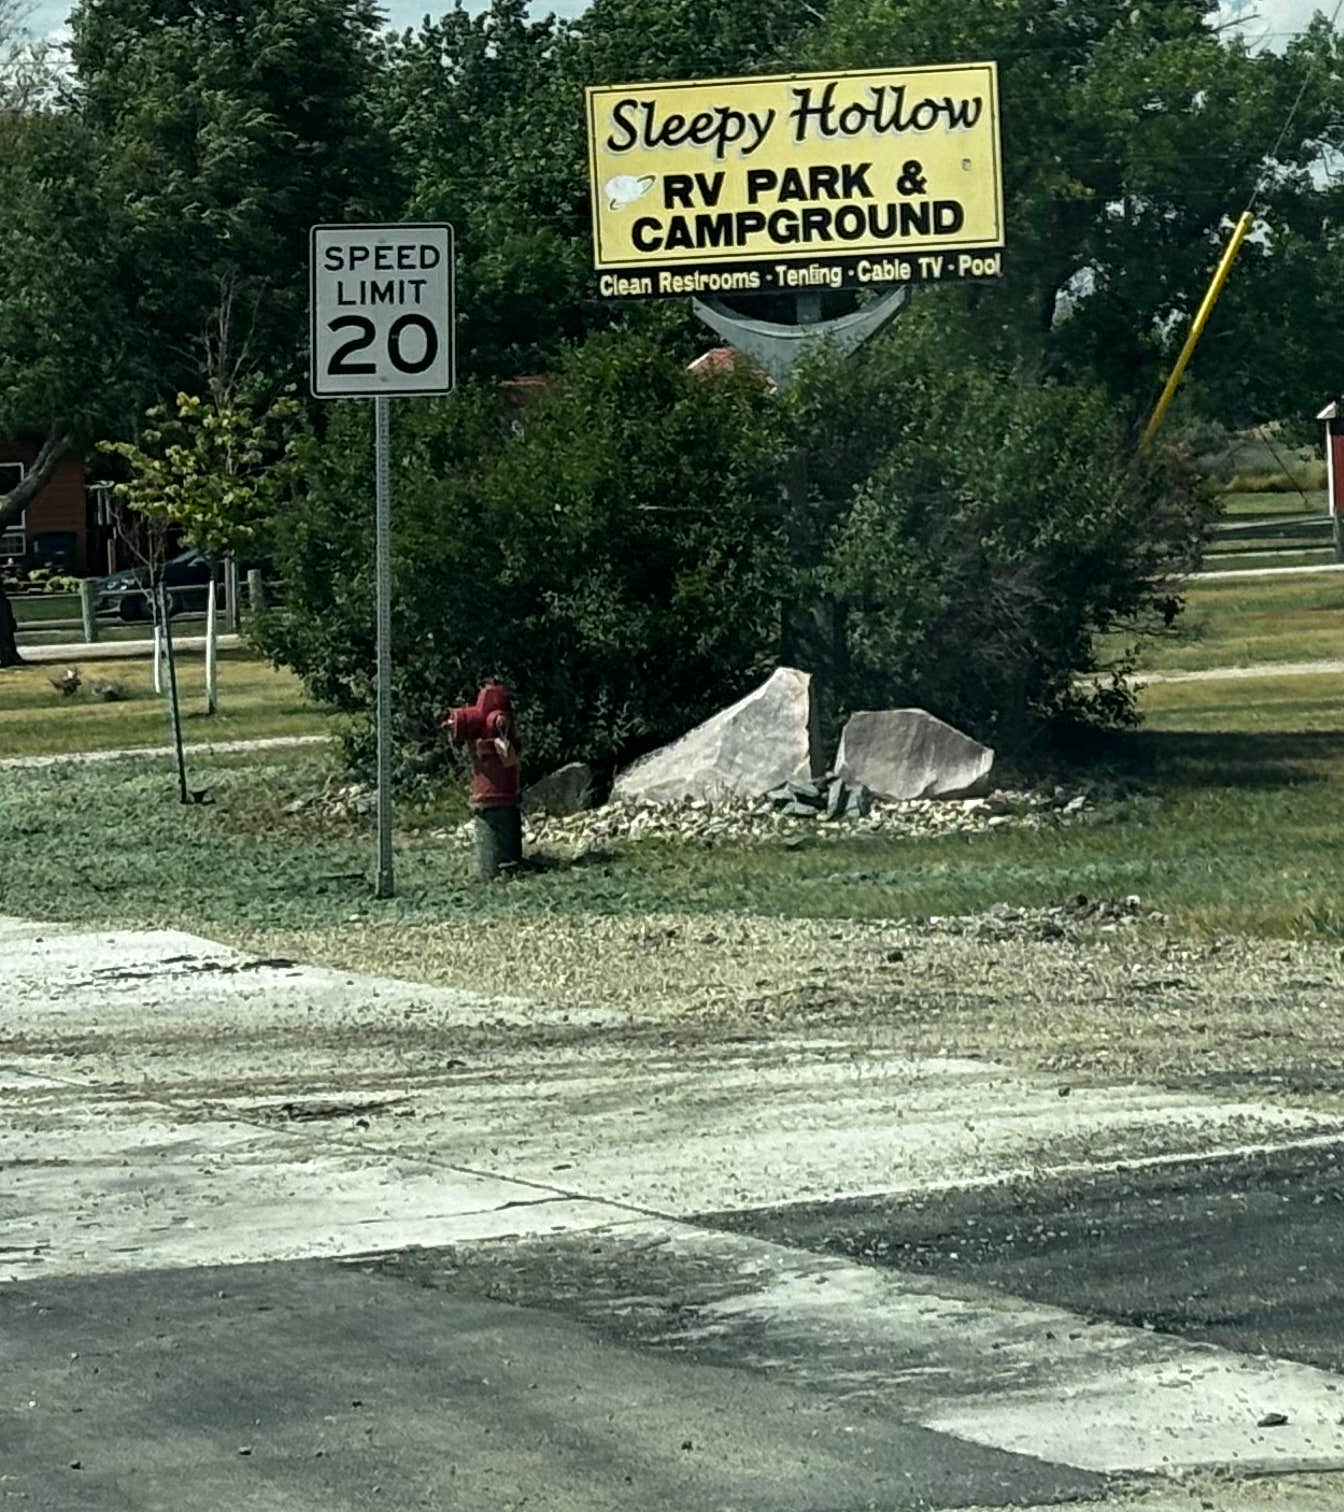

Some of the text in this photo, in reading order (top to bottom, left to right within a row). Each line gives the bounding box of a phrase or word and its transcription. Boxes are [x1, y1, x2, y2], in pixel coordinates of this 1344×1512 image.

[605, 81, 983, 159] Sleepy Hollow
[663, 159, 928, 210] RV PARK &
[631, 199, 964, 253] CAMPGROUND
[324, 244, 440, 271] SPEED
[599, 273, 652, 297] Clean
[658, 268, 761, 295] Restrooms
[857, 258, 912, 284] Cable
[917, 255, 943, 278] TV
[957, 251, 1001, 276] Pool
[337, 279, 428, 306] LIMIT
[327, 313, 438, 375] 20
